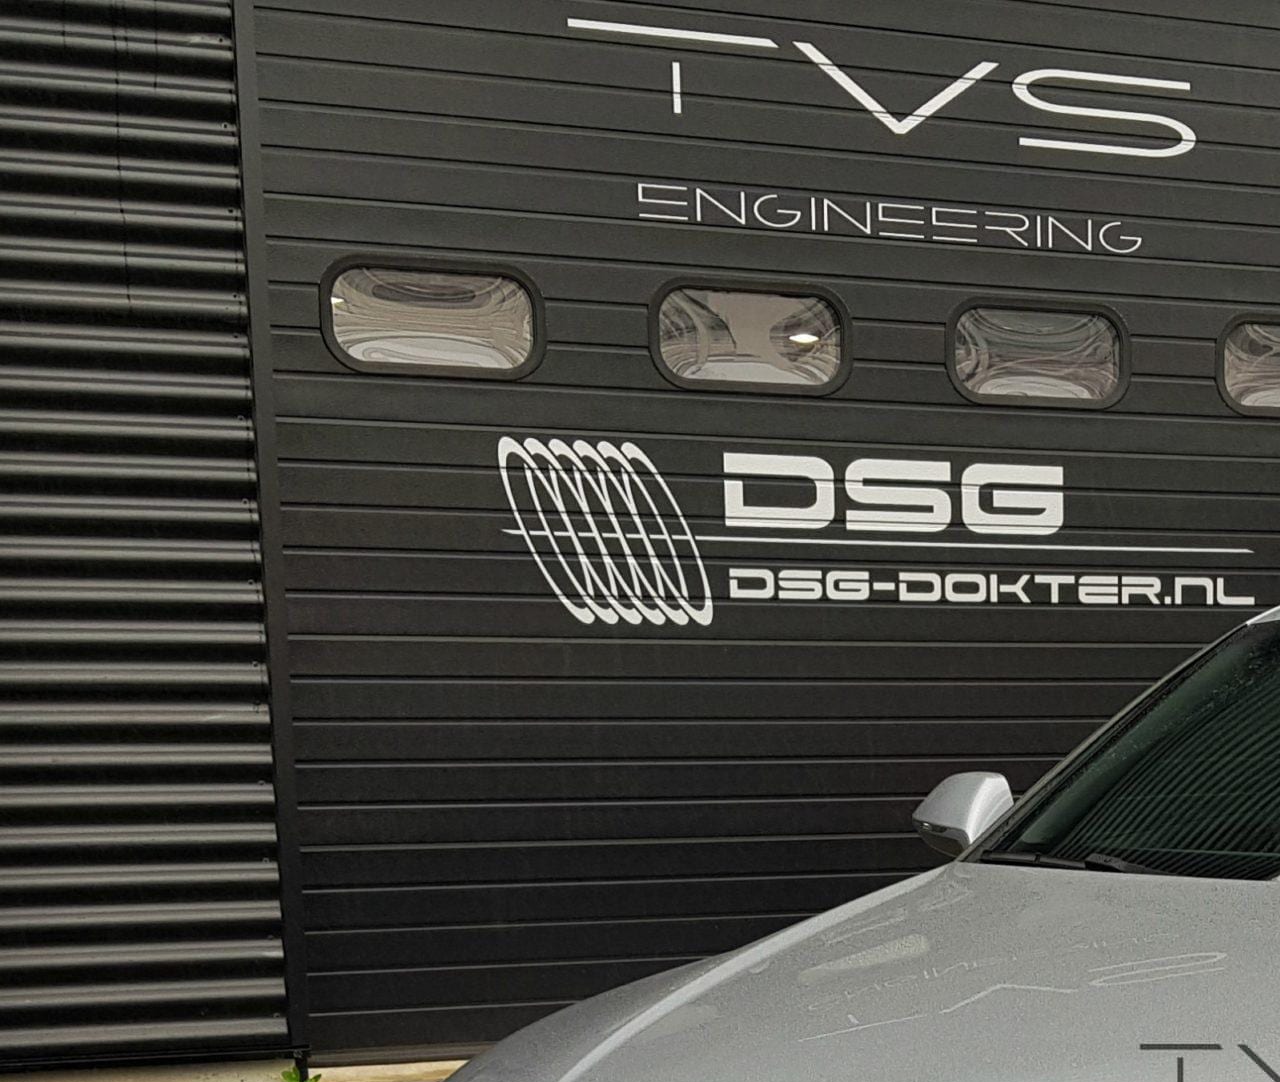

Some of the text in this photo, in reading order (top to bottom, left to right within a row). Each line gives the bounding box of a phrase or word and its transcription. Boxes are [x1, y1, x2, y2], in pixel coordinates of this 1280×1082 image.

[567, 18, 1197, 158] TVS
[637, 182, 1143, 254] ENGINEERING
[723, 452, 1064, 536] DSG
[729, 568, 1255, 605] DSG-DOKTER.NL
